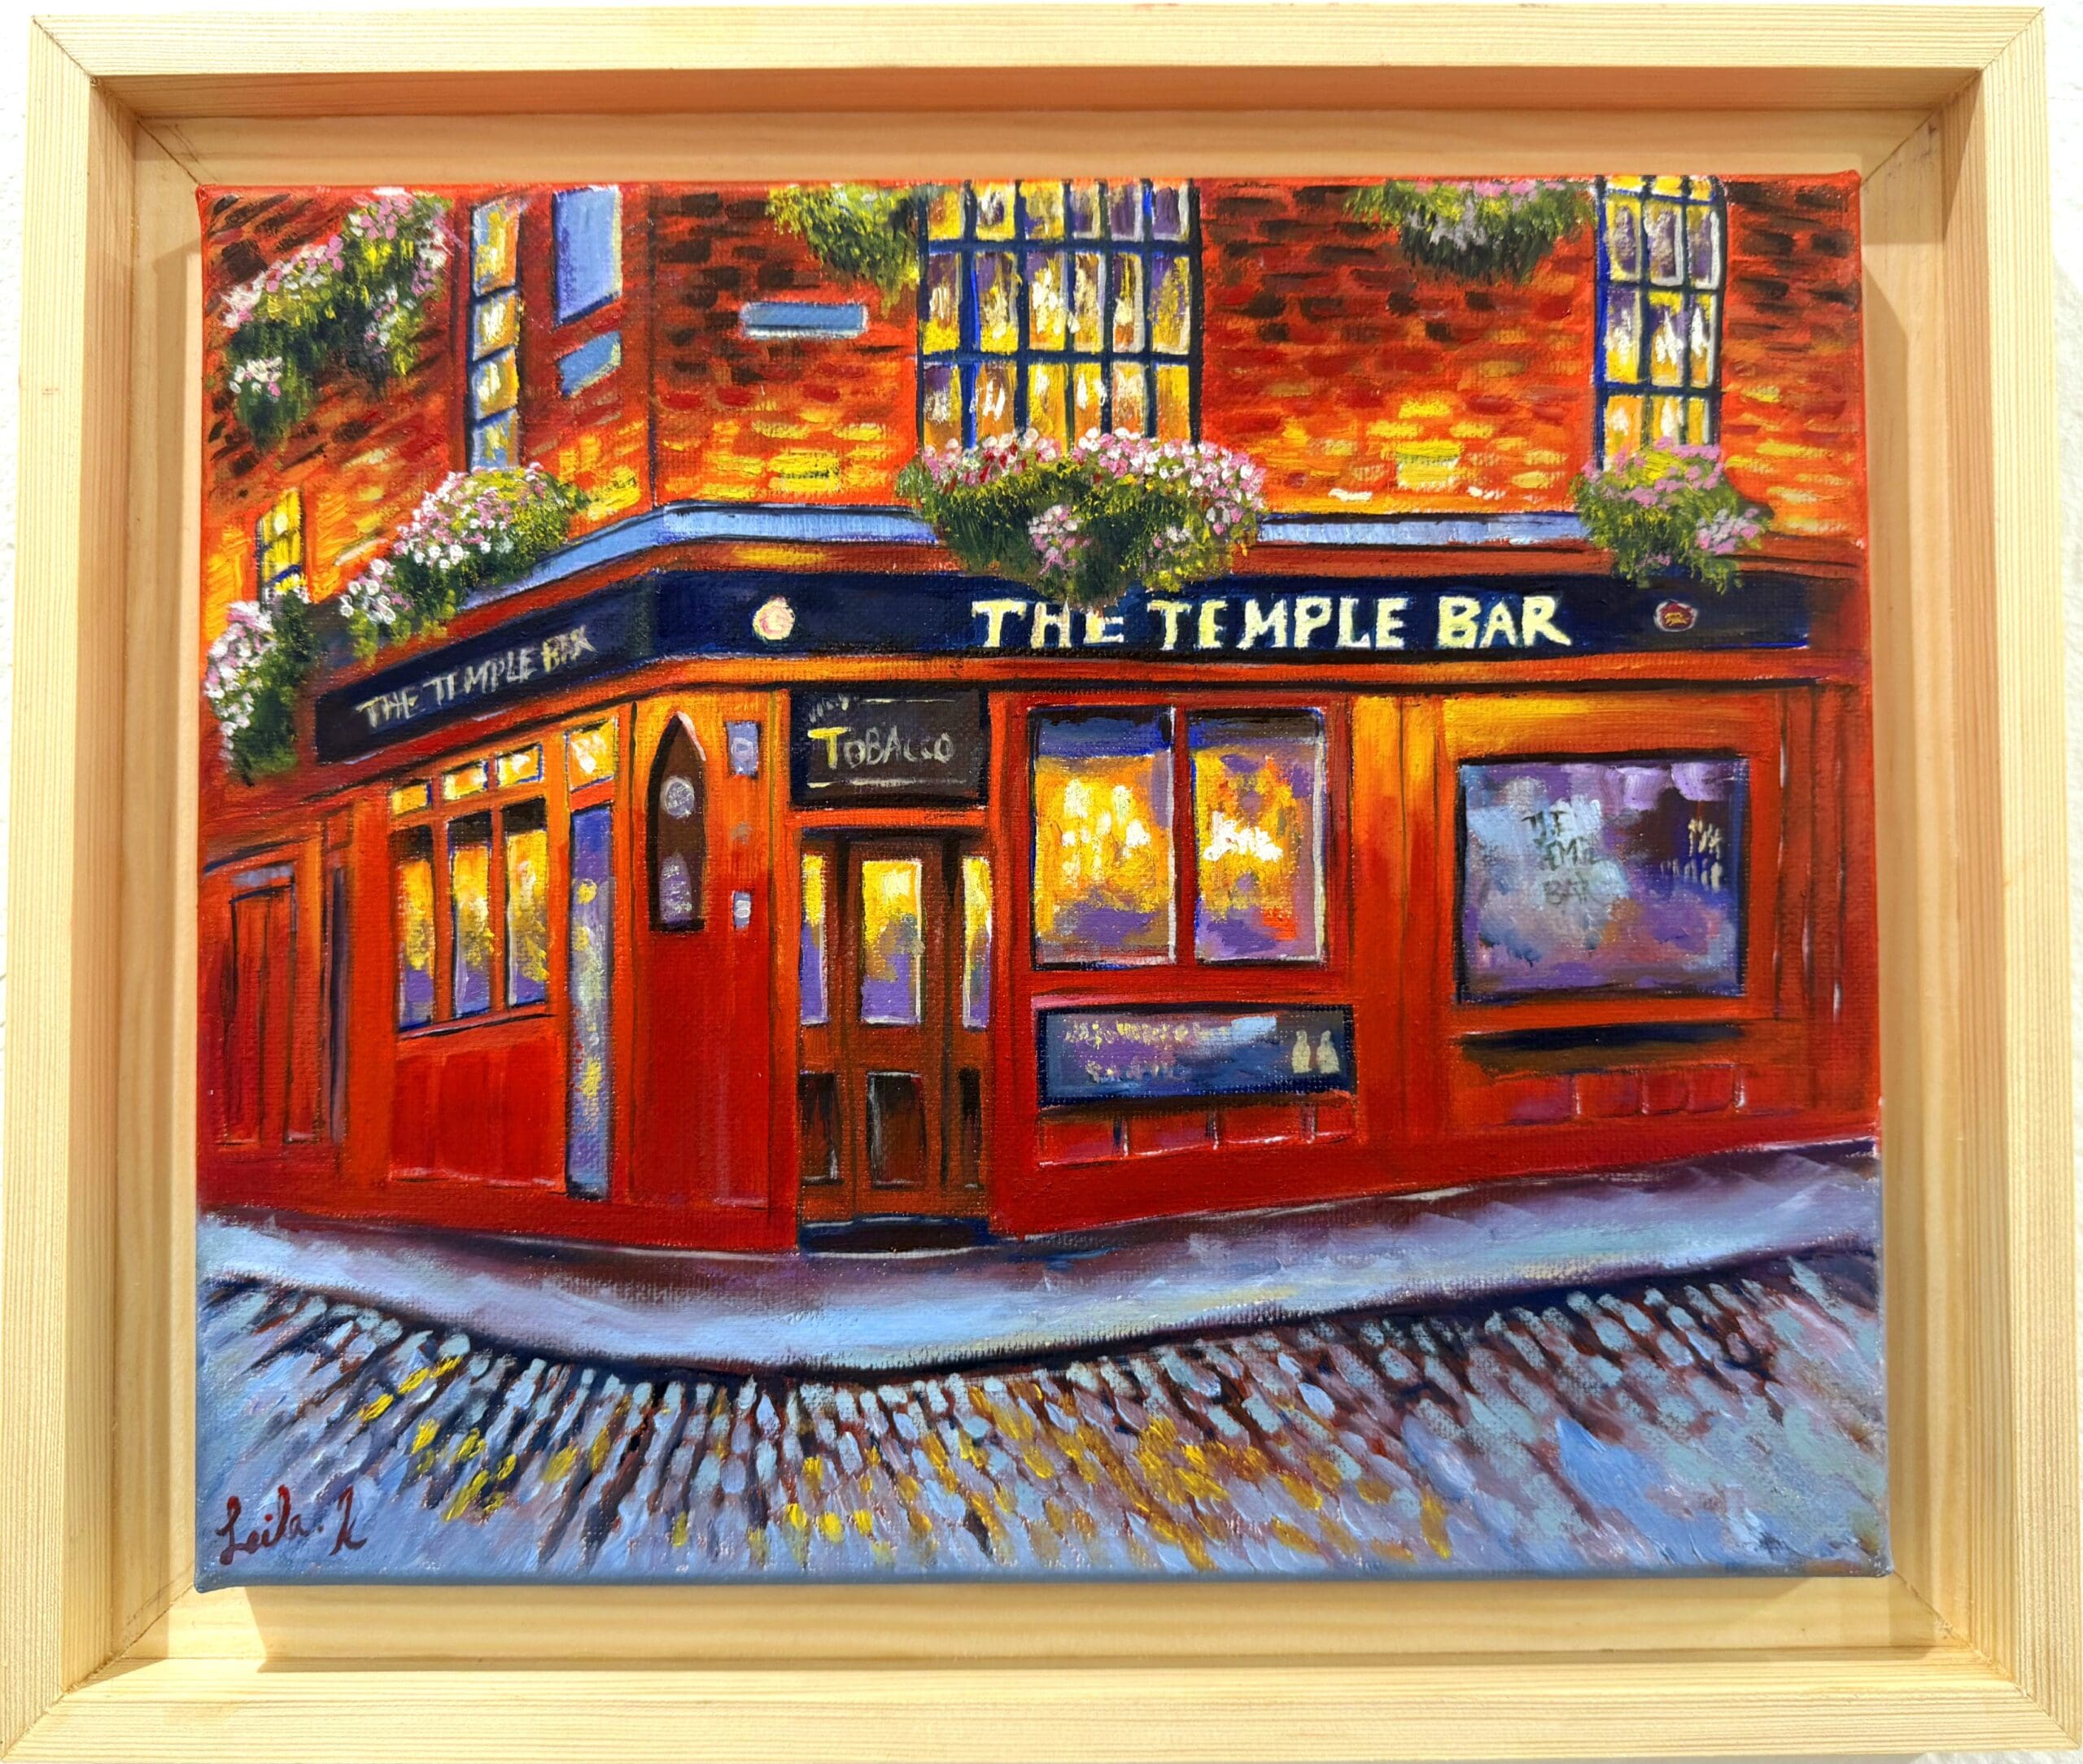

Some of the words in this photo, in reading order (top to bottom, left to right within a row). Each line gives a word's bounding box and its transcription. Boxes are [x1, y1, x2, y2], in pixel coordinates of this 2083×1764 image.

[972, 599, 1125, 649] THE
[1146, 594, 1408, 650] TEMPLE
[1438, 596, 1573, 650] BAR
[354, 688, 426, 727] THE
